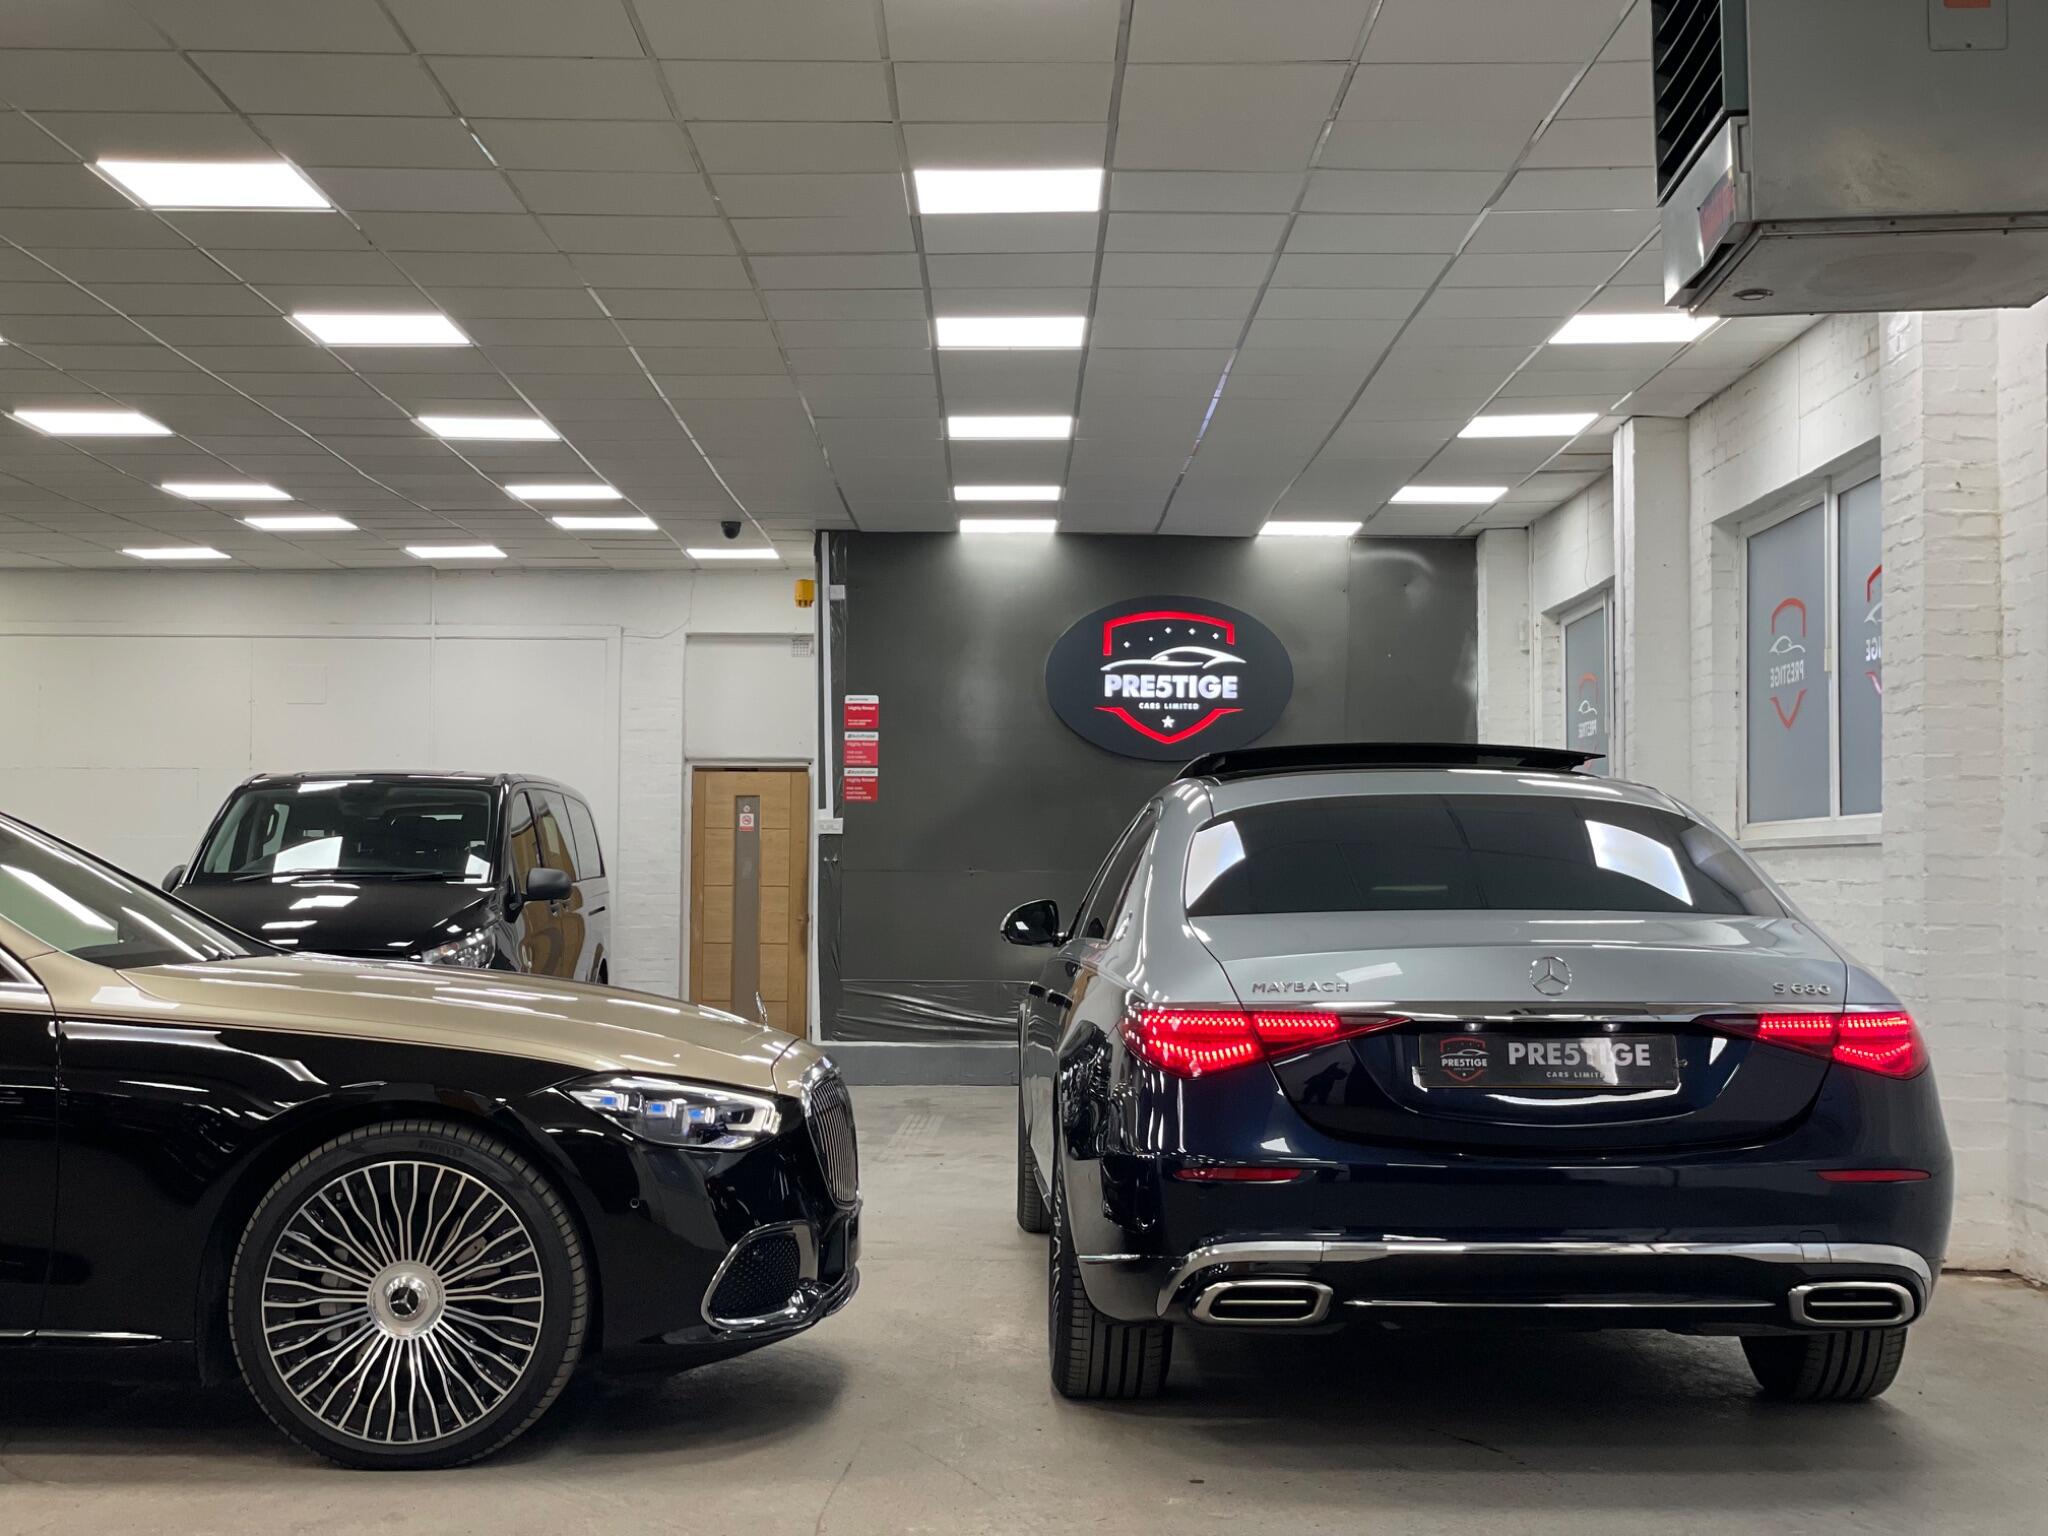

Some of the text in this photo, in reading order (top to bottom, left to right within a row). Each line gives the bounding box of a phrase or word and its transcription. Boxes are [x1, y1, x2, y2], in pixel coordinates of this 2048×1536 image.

[1139, 702, 1199, 710] CARS LIMITED
[1252, 981, 1350, 993] MAYBACH
[1773, 982, 1786, 995] S
[1546, 1071, 1611, 1079] CARS LIMIT
